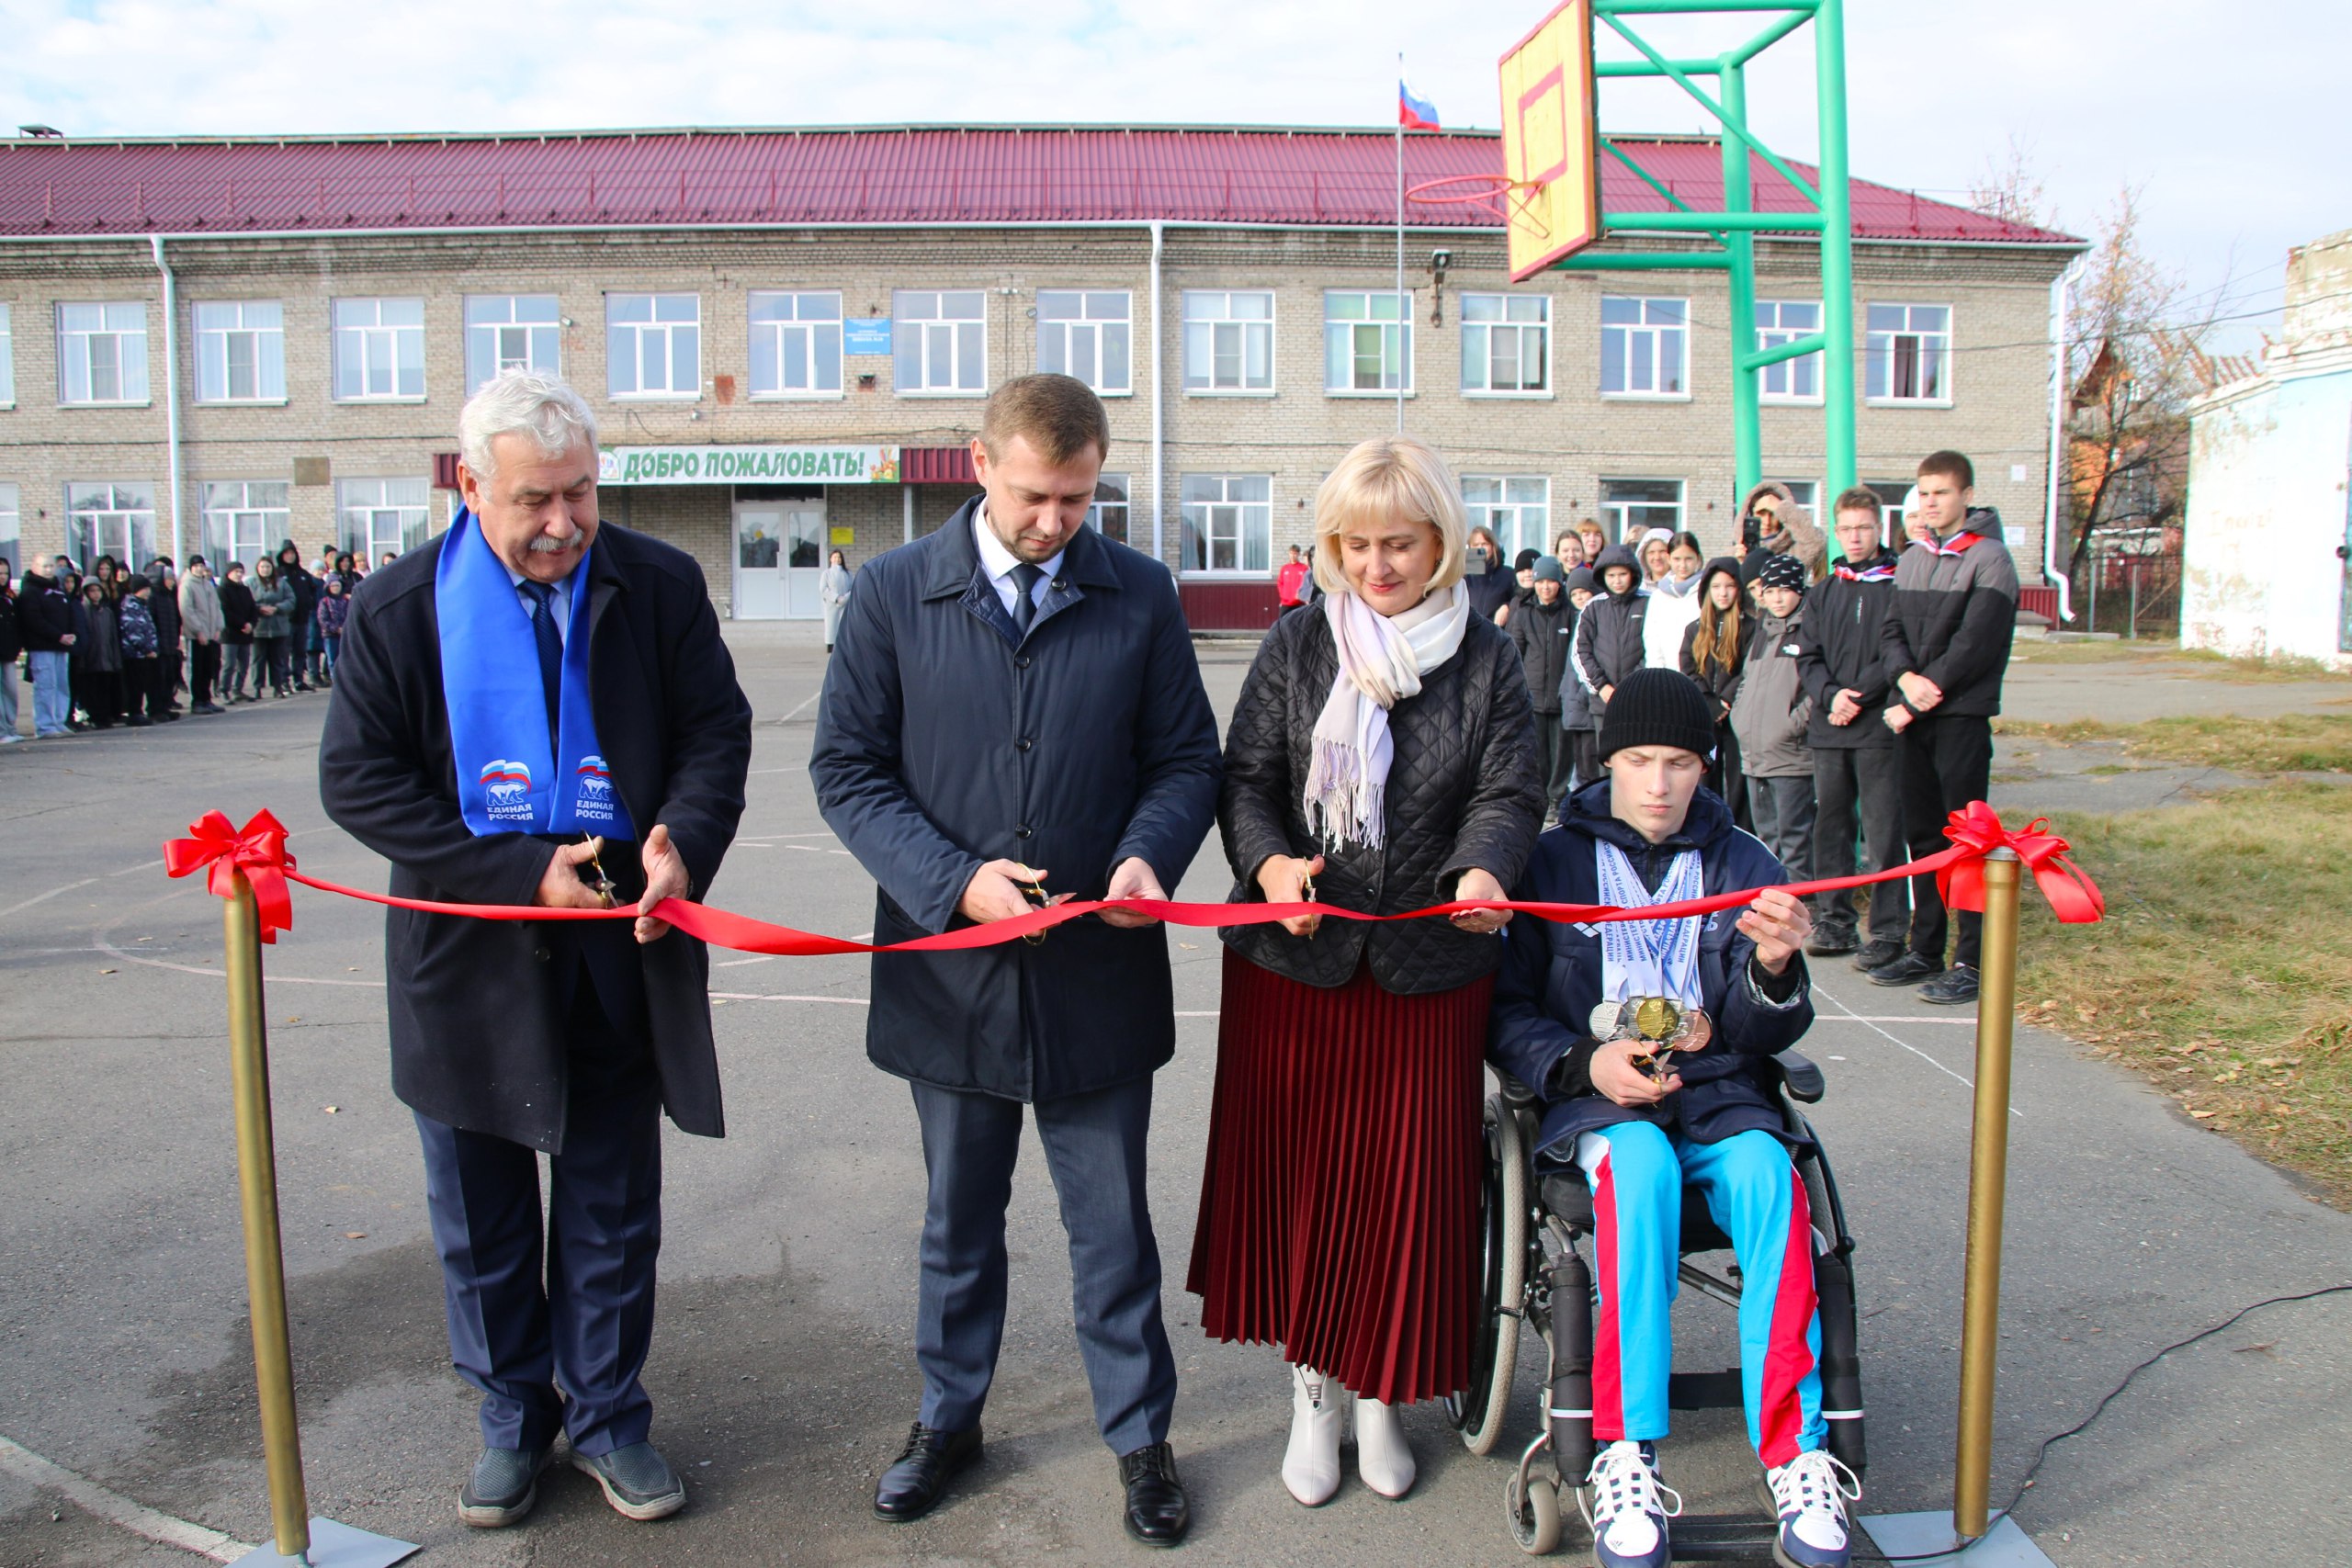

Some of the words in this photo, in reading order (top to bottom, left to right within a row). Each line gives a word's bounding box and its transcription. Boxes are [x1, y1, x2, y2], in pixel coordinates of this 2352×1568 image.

[624, 452, 700, 481] ДОБРО
[706, 452, 865, 477] ПОЖАЛОВАТЬ!
[487, 804, 532, 813] ЕДИНАЯ
[577, 800, 614, 811] ЕДИНАЯ
[489, 812, 534, 820] РОССИЯ
[575, 808, 613, 820] РОССИЯ
